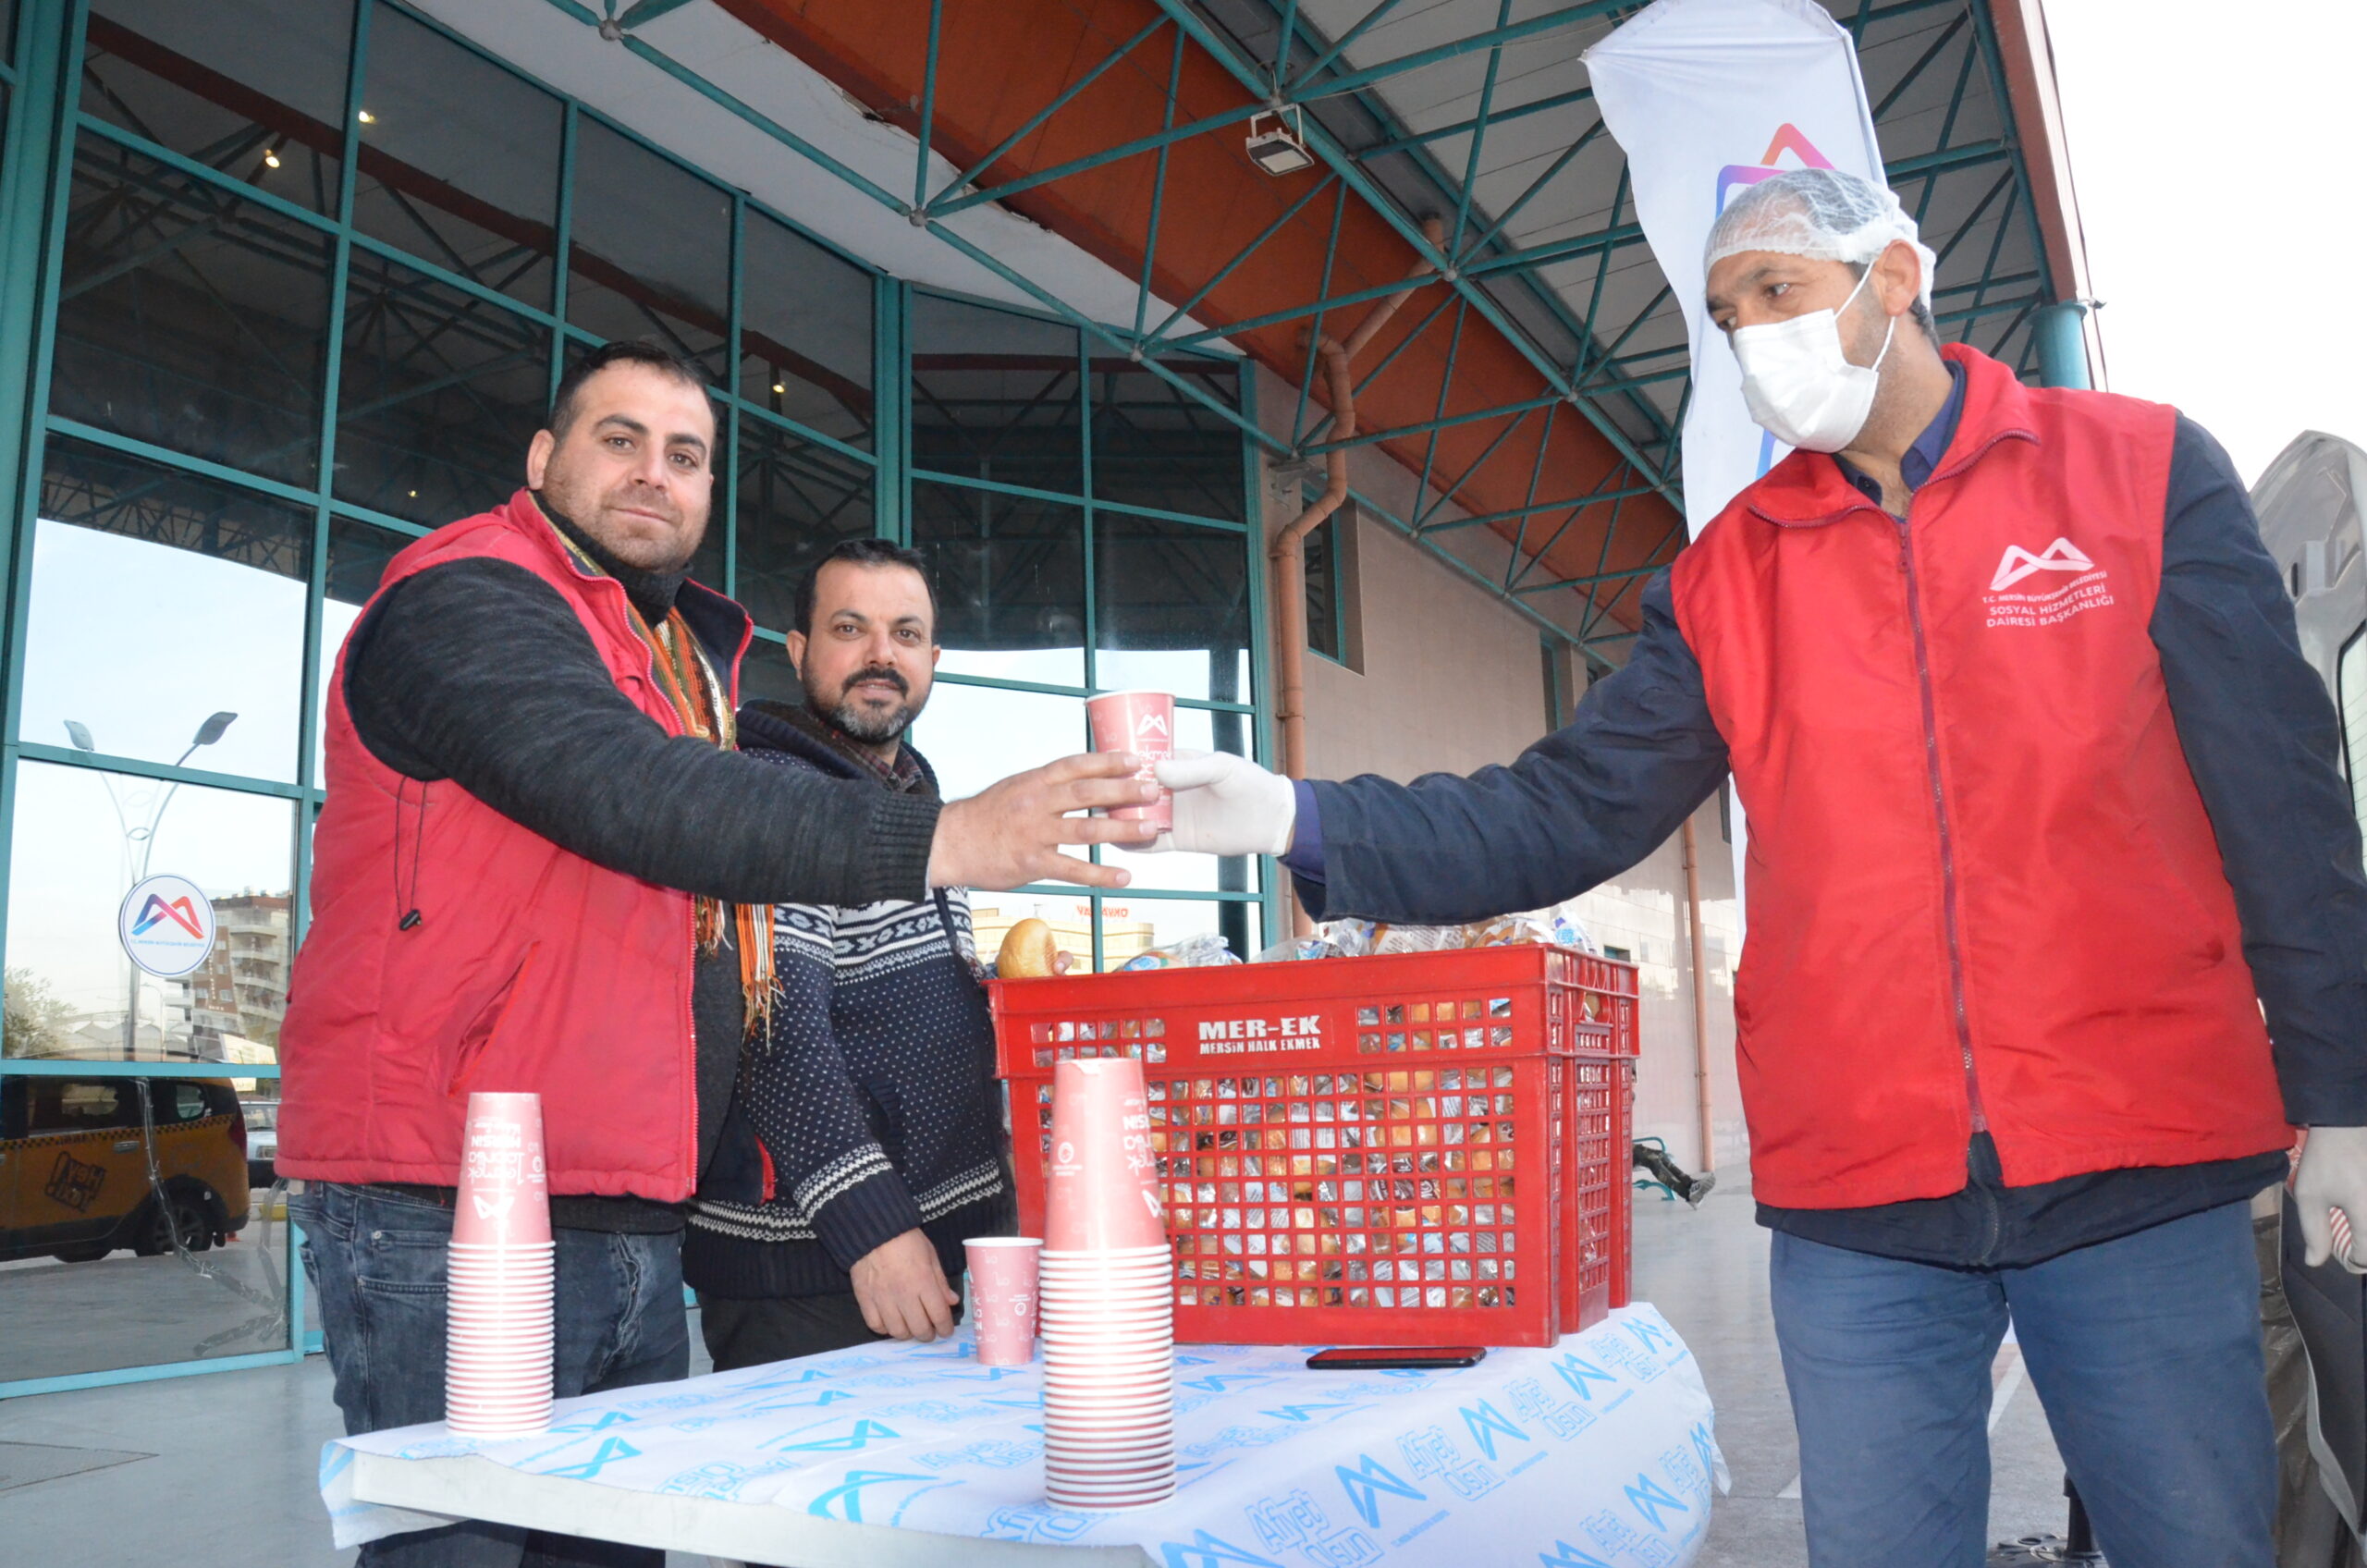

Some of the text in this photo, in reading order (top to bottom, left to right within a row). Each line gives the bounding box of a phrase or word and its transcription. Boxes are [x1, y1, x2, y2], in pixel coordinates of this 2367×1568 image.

[1982, 595, 1997, 604] T.C.
[1985, 594, 2115, 628] DAİRESİ BAŞKANLIĞI
[1989, 582, 2106, 616] SOSYAL HİZMETLERİ
[1198, 1015, 1322, 1040] MER-EK
[1247, 1039, 1278, 1053] HALK
[1280, 1036, 1321, 1051] EKMEK
[1395, 1424, 1461, 1481] Afiyet
[1439, 1458, 1506, 1502] Olsun
[1244, 1488, 1331, 1556] Afiyet
[1297, 1525, 1386, 1568] Olsun
